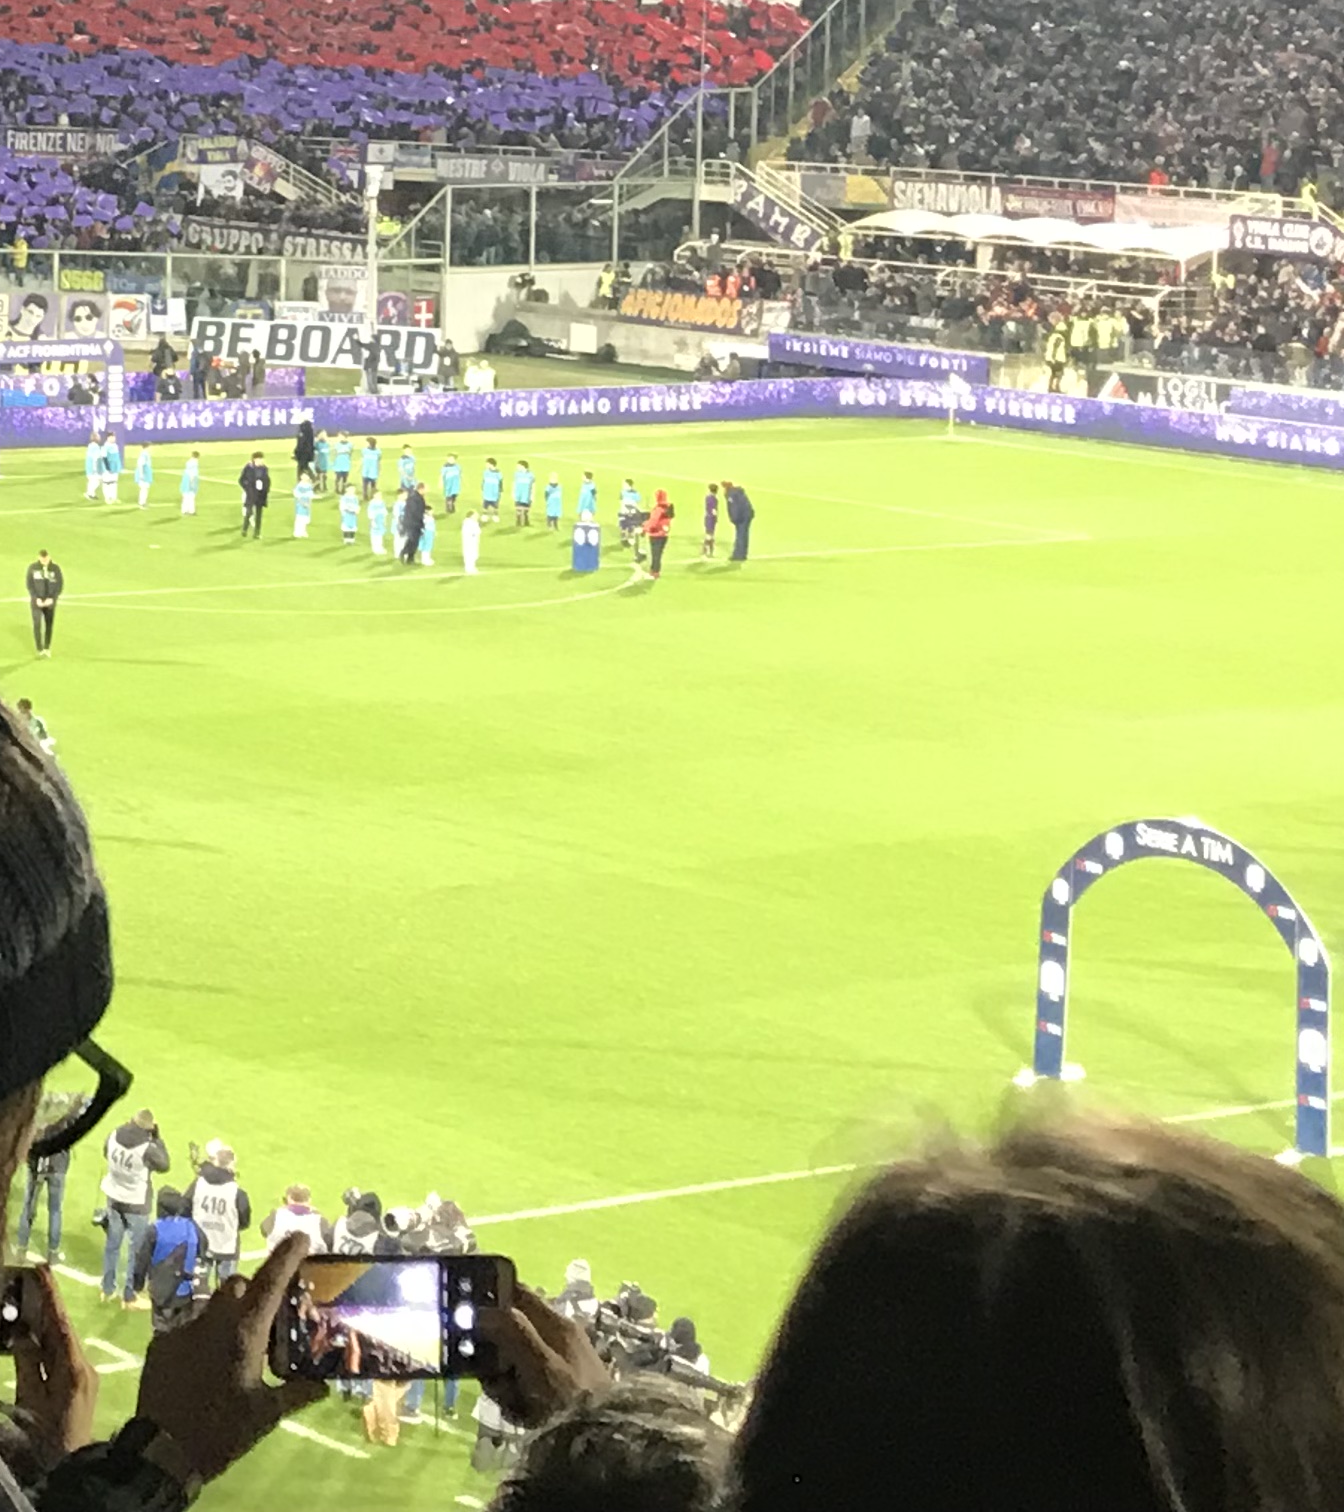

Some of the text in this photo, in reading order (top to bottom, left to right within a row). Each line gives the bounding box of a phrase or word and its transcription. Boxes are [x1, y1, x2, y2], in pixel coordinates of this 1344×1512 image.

[6, 130, 64, 153] FIRENZE
[187, 222, 370, 260] GRUPPO STRESSA
[6, 342, 102, 359] ACF FIORENTINA
[918, 353, 968, 372] FORTI
[1157, 376, 1217, 400] LOGLI
[499, 394, 703, 418] NOI SIAMO FIRENZE
[839, 387, 888, 407] NOI
[984, 398, 1077, 425] FIRENZE
[92, 406, 315, 432] NI SIAMO FIRENZE
[1266, 431, 1342, 456] SIAMO
[1181, 834, 1198, 858] A
[1200, 837, 1234, 866] TIM
[111, 1145, 133, 1171] 414
[200, 1197, 227, 1215] 410
